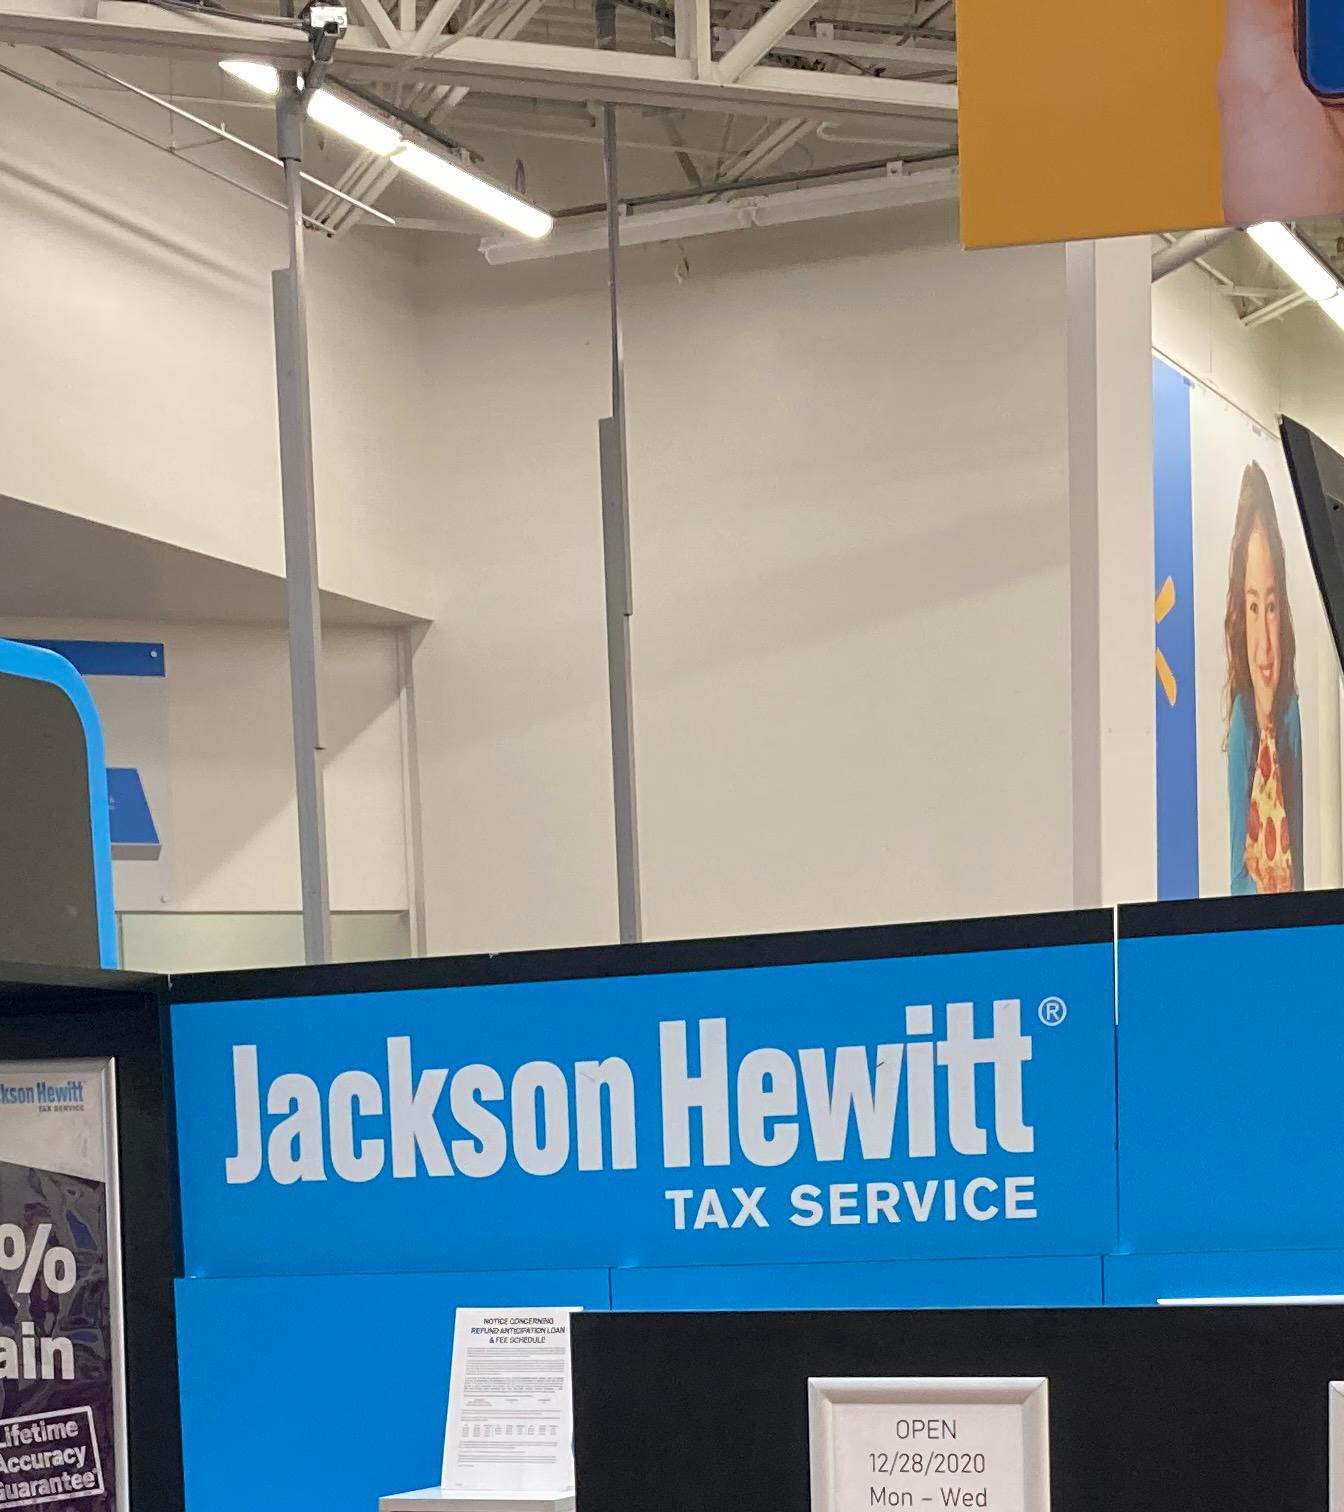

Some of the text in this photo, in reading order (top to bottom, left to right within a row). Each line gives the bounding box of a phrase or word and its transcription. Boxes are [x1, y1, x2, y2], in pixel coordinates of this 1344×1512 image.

[36, 1080, 84, 1103] Hewitt
[225, 1035, 638, 1185] Jackson
[666, 1175, 1037, 1231] TAX SERVICE
[471, 1327, 499, 1335] REFUND
[547, 1326, 566, 1334] LOAN
[496, 1336, 509, 1344] FEE
[895, 1419, 957, 1440] OPEN
[869, 1452, 986, 1477] 12/28/2020
[869, 1486, 913, 1507] Mon
[940, 1487, 988, 1508] Wed
